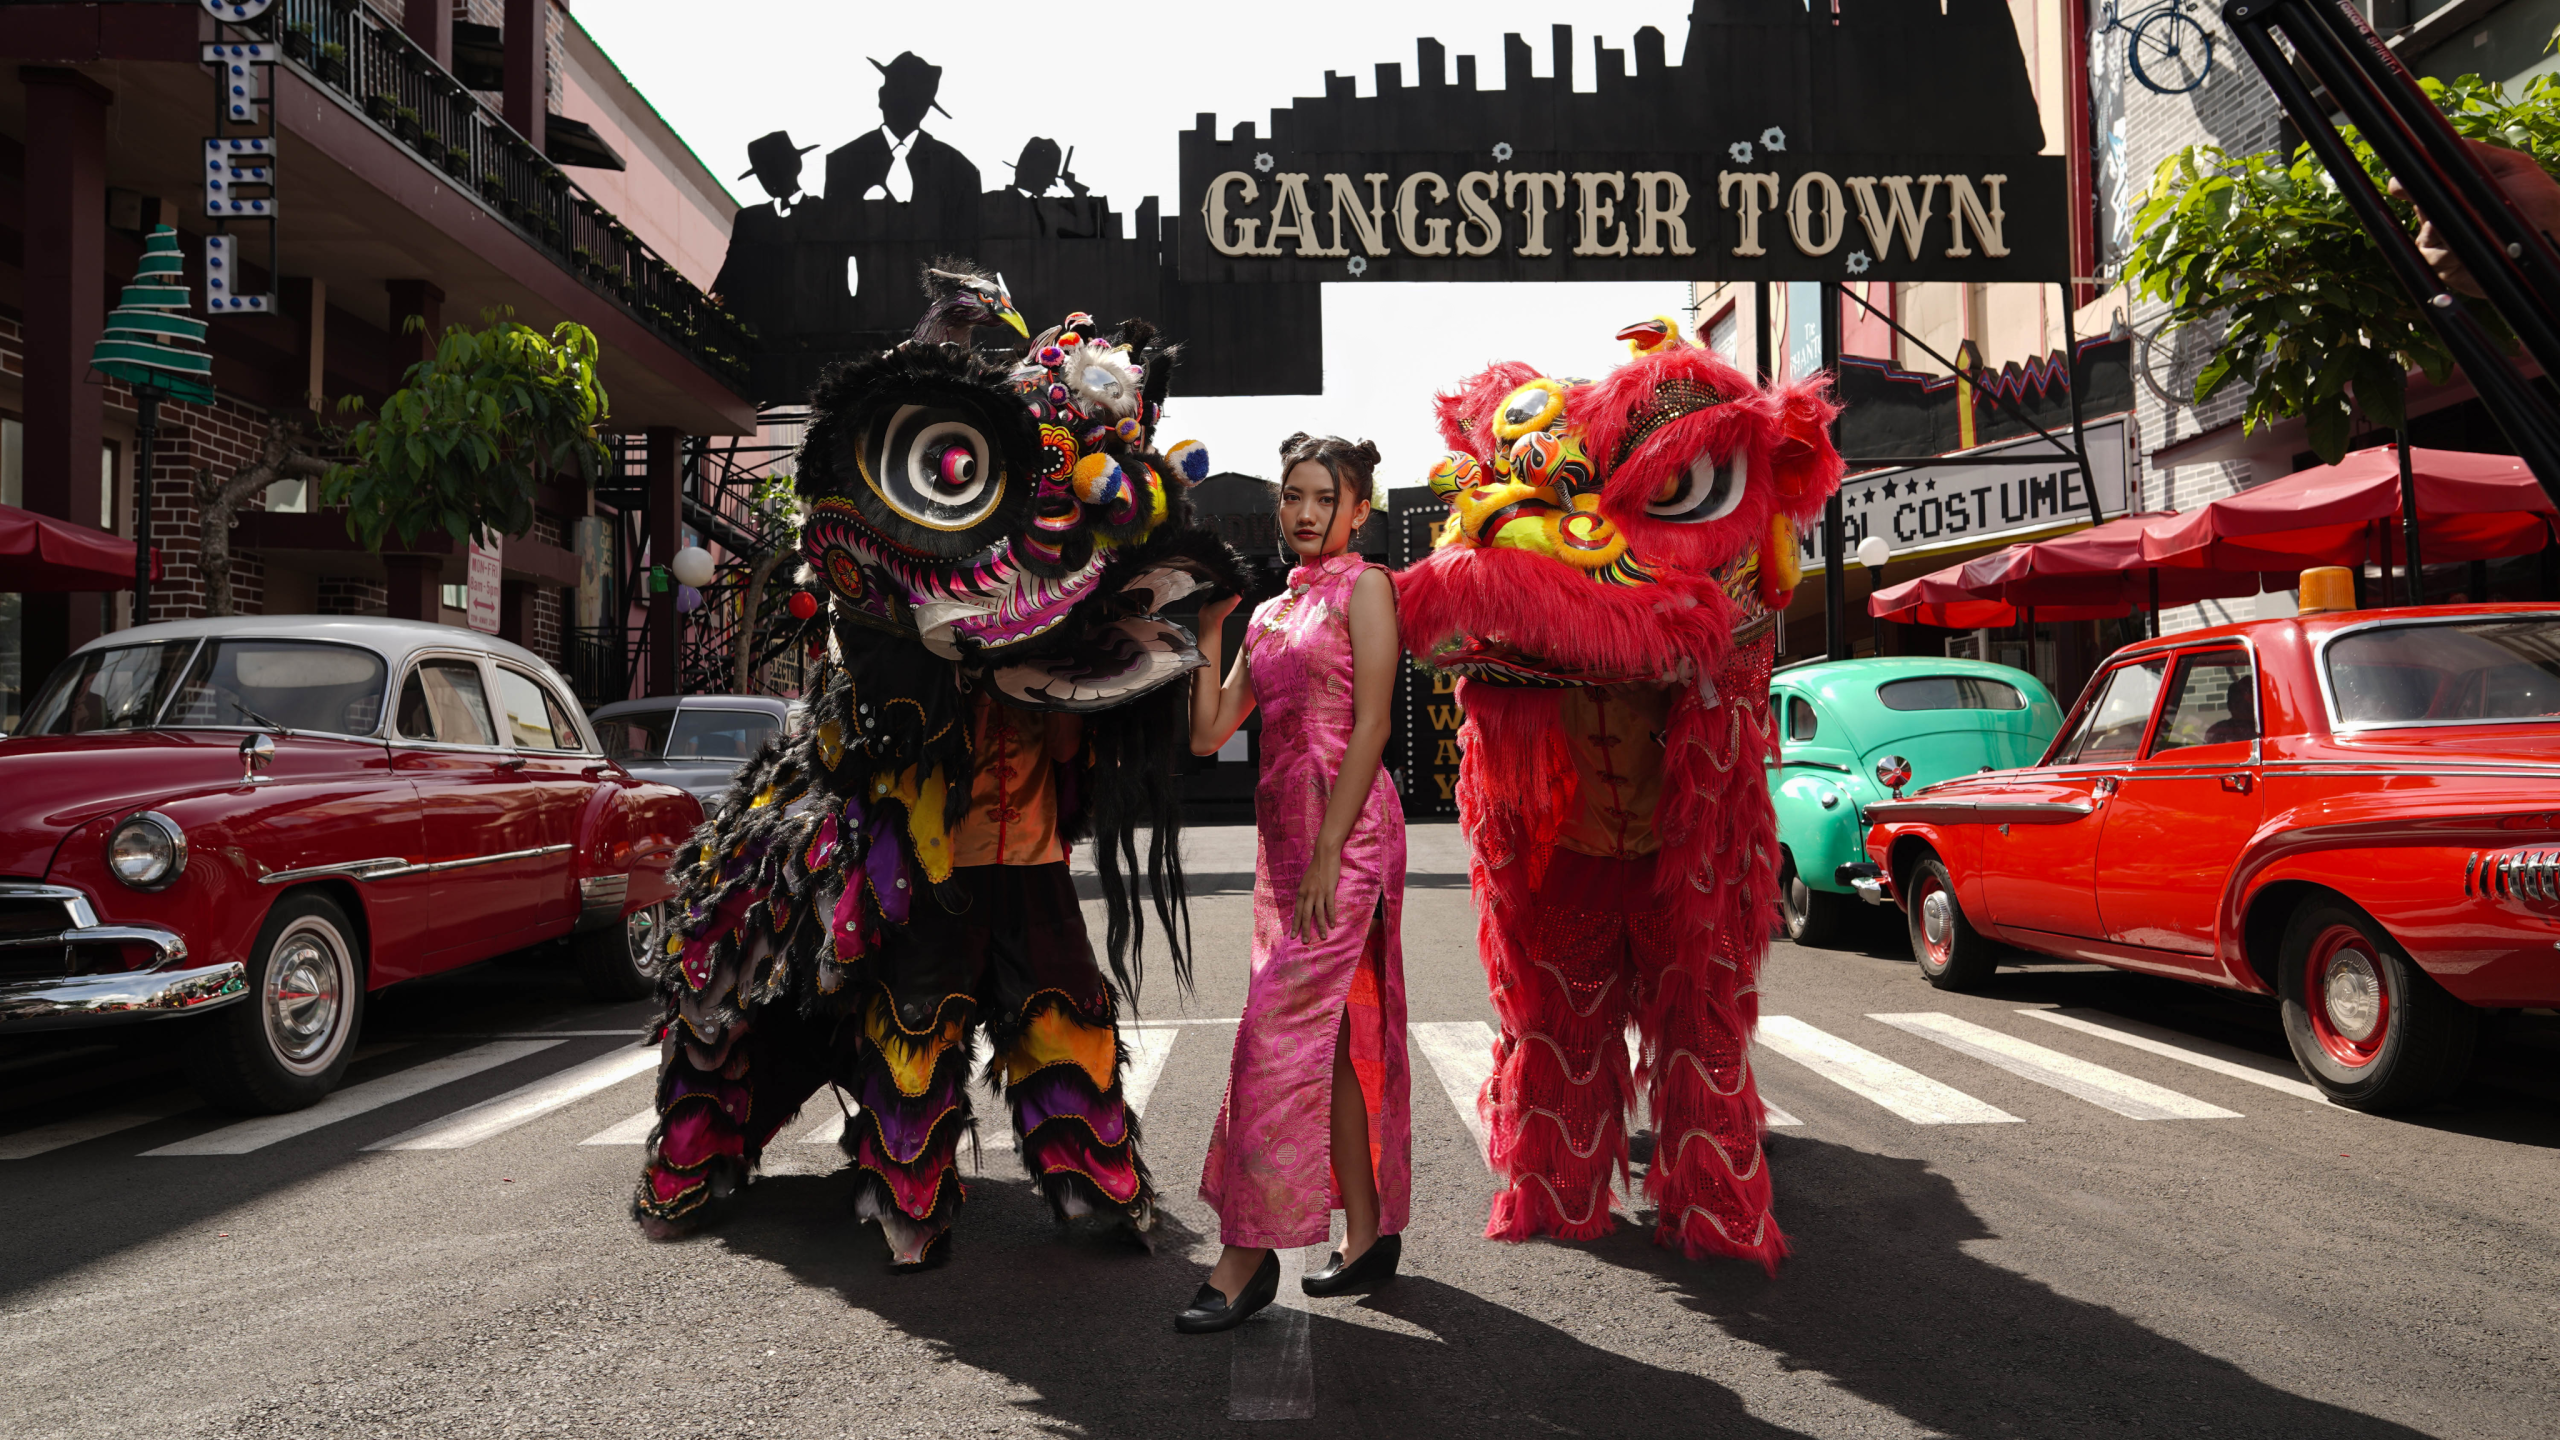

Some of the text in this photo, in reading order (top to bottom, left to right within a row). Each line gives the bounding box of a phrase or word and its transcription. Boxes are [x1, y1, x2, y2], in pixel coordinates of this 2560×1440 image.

[203, 0, 275, 314] TEL
[1201, 170, 2012, 262] GANGSTER TOWN
[1798, 467, 2090, 559] NTAL COSTUME
[472, 558, 497, 577] MON-FRI
